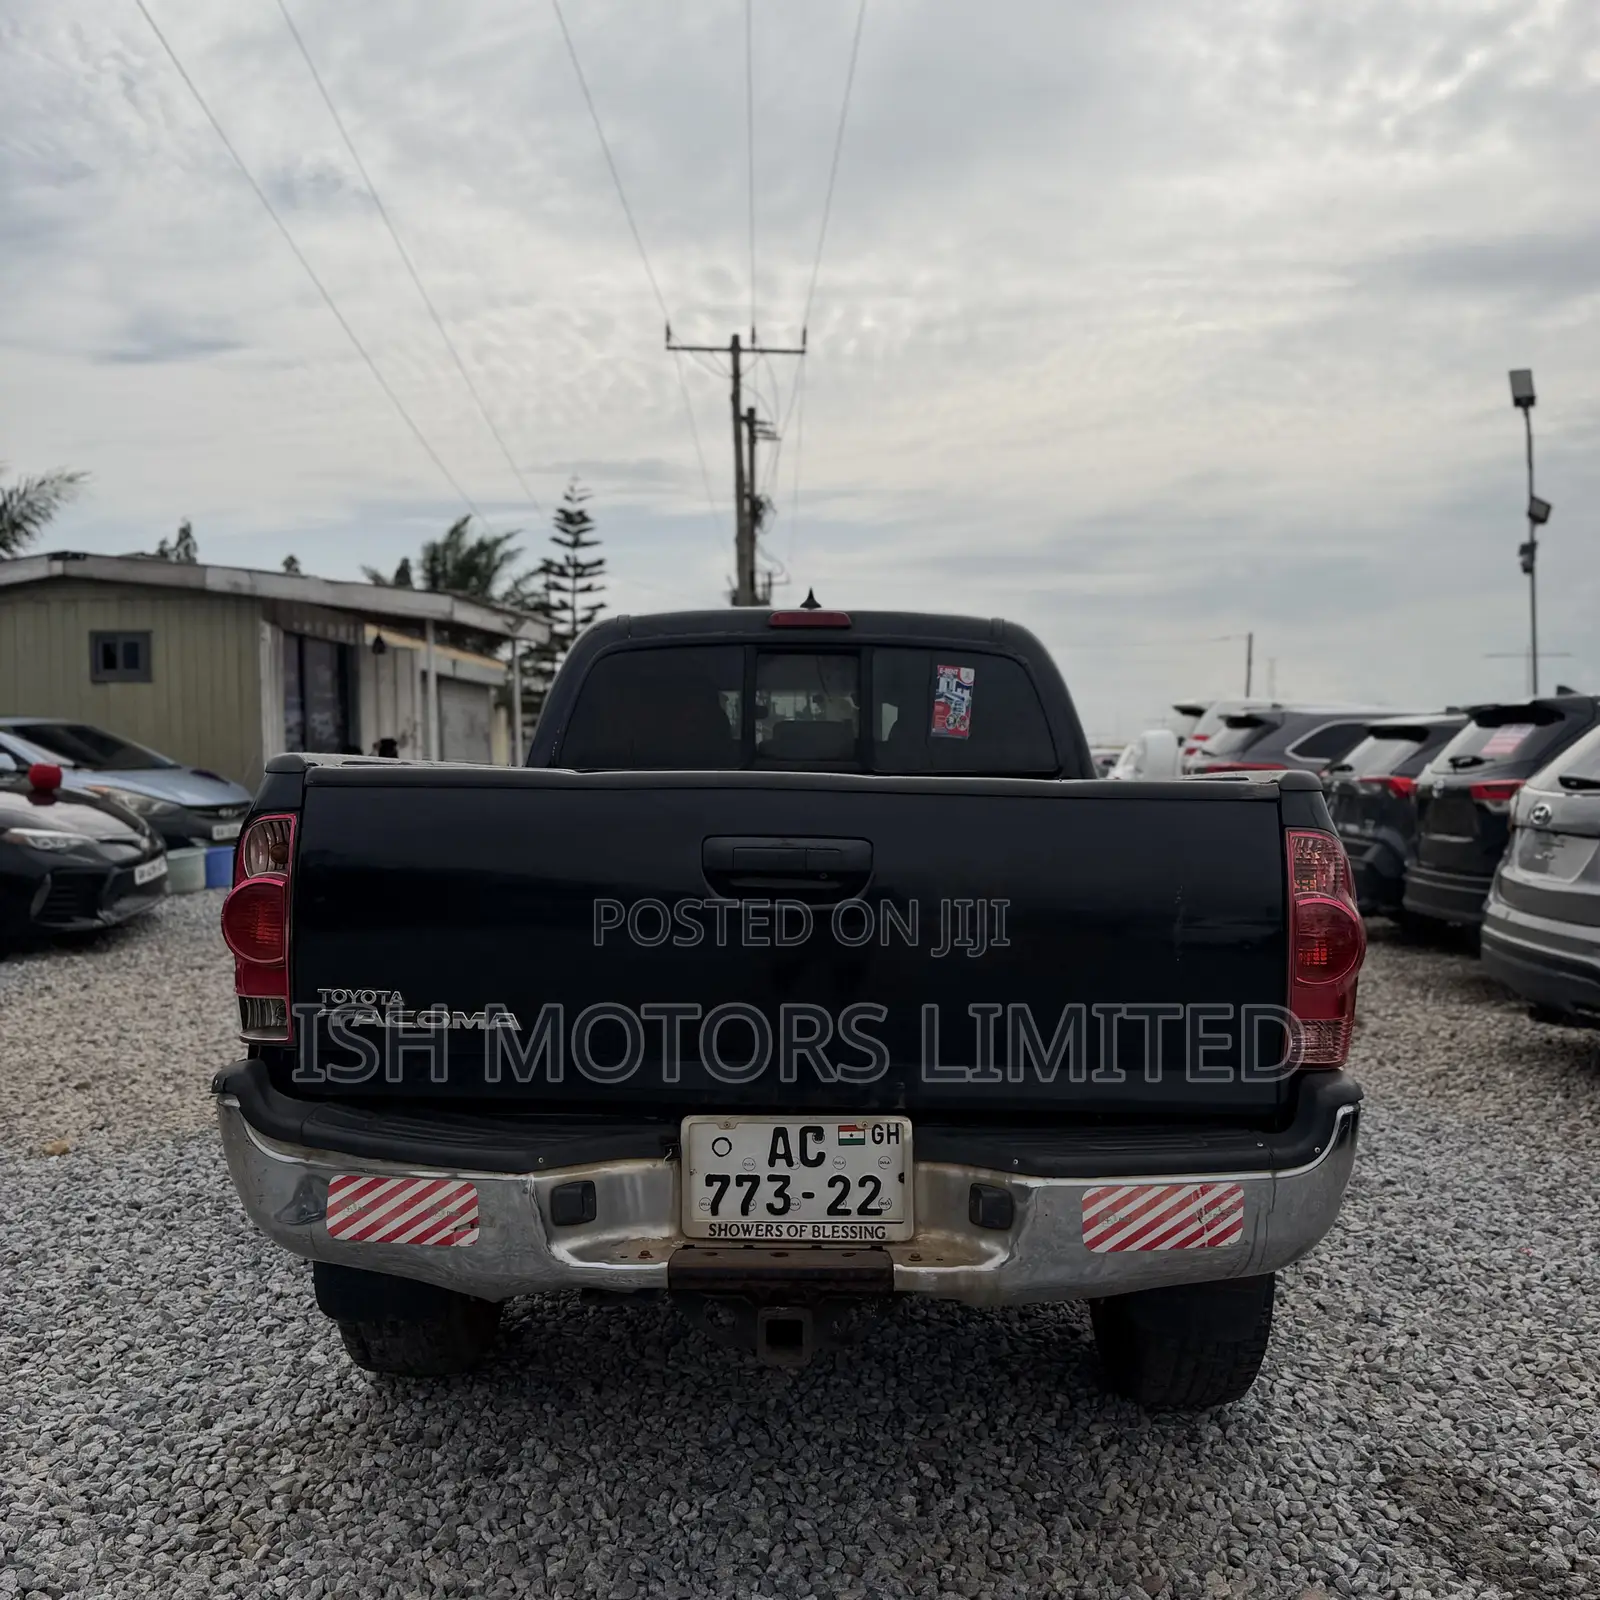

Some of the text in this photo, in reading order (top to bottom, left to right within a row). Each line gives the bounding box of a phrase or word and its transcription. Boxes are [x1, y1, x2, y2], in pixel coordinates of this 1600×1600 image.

[317, 988, 405, 1006] TOYOTA
[317, 1008, 522, 1031] TACOMA
[871, 1123, 900, 1145] GH
[767, 1125, 826, 1168] AC
[705, 1173, 883, 1217] 773-22
[708, 1223, 886, 1240] SHOWERS OF BLESSING
